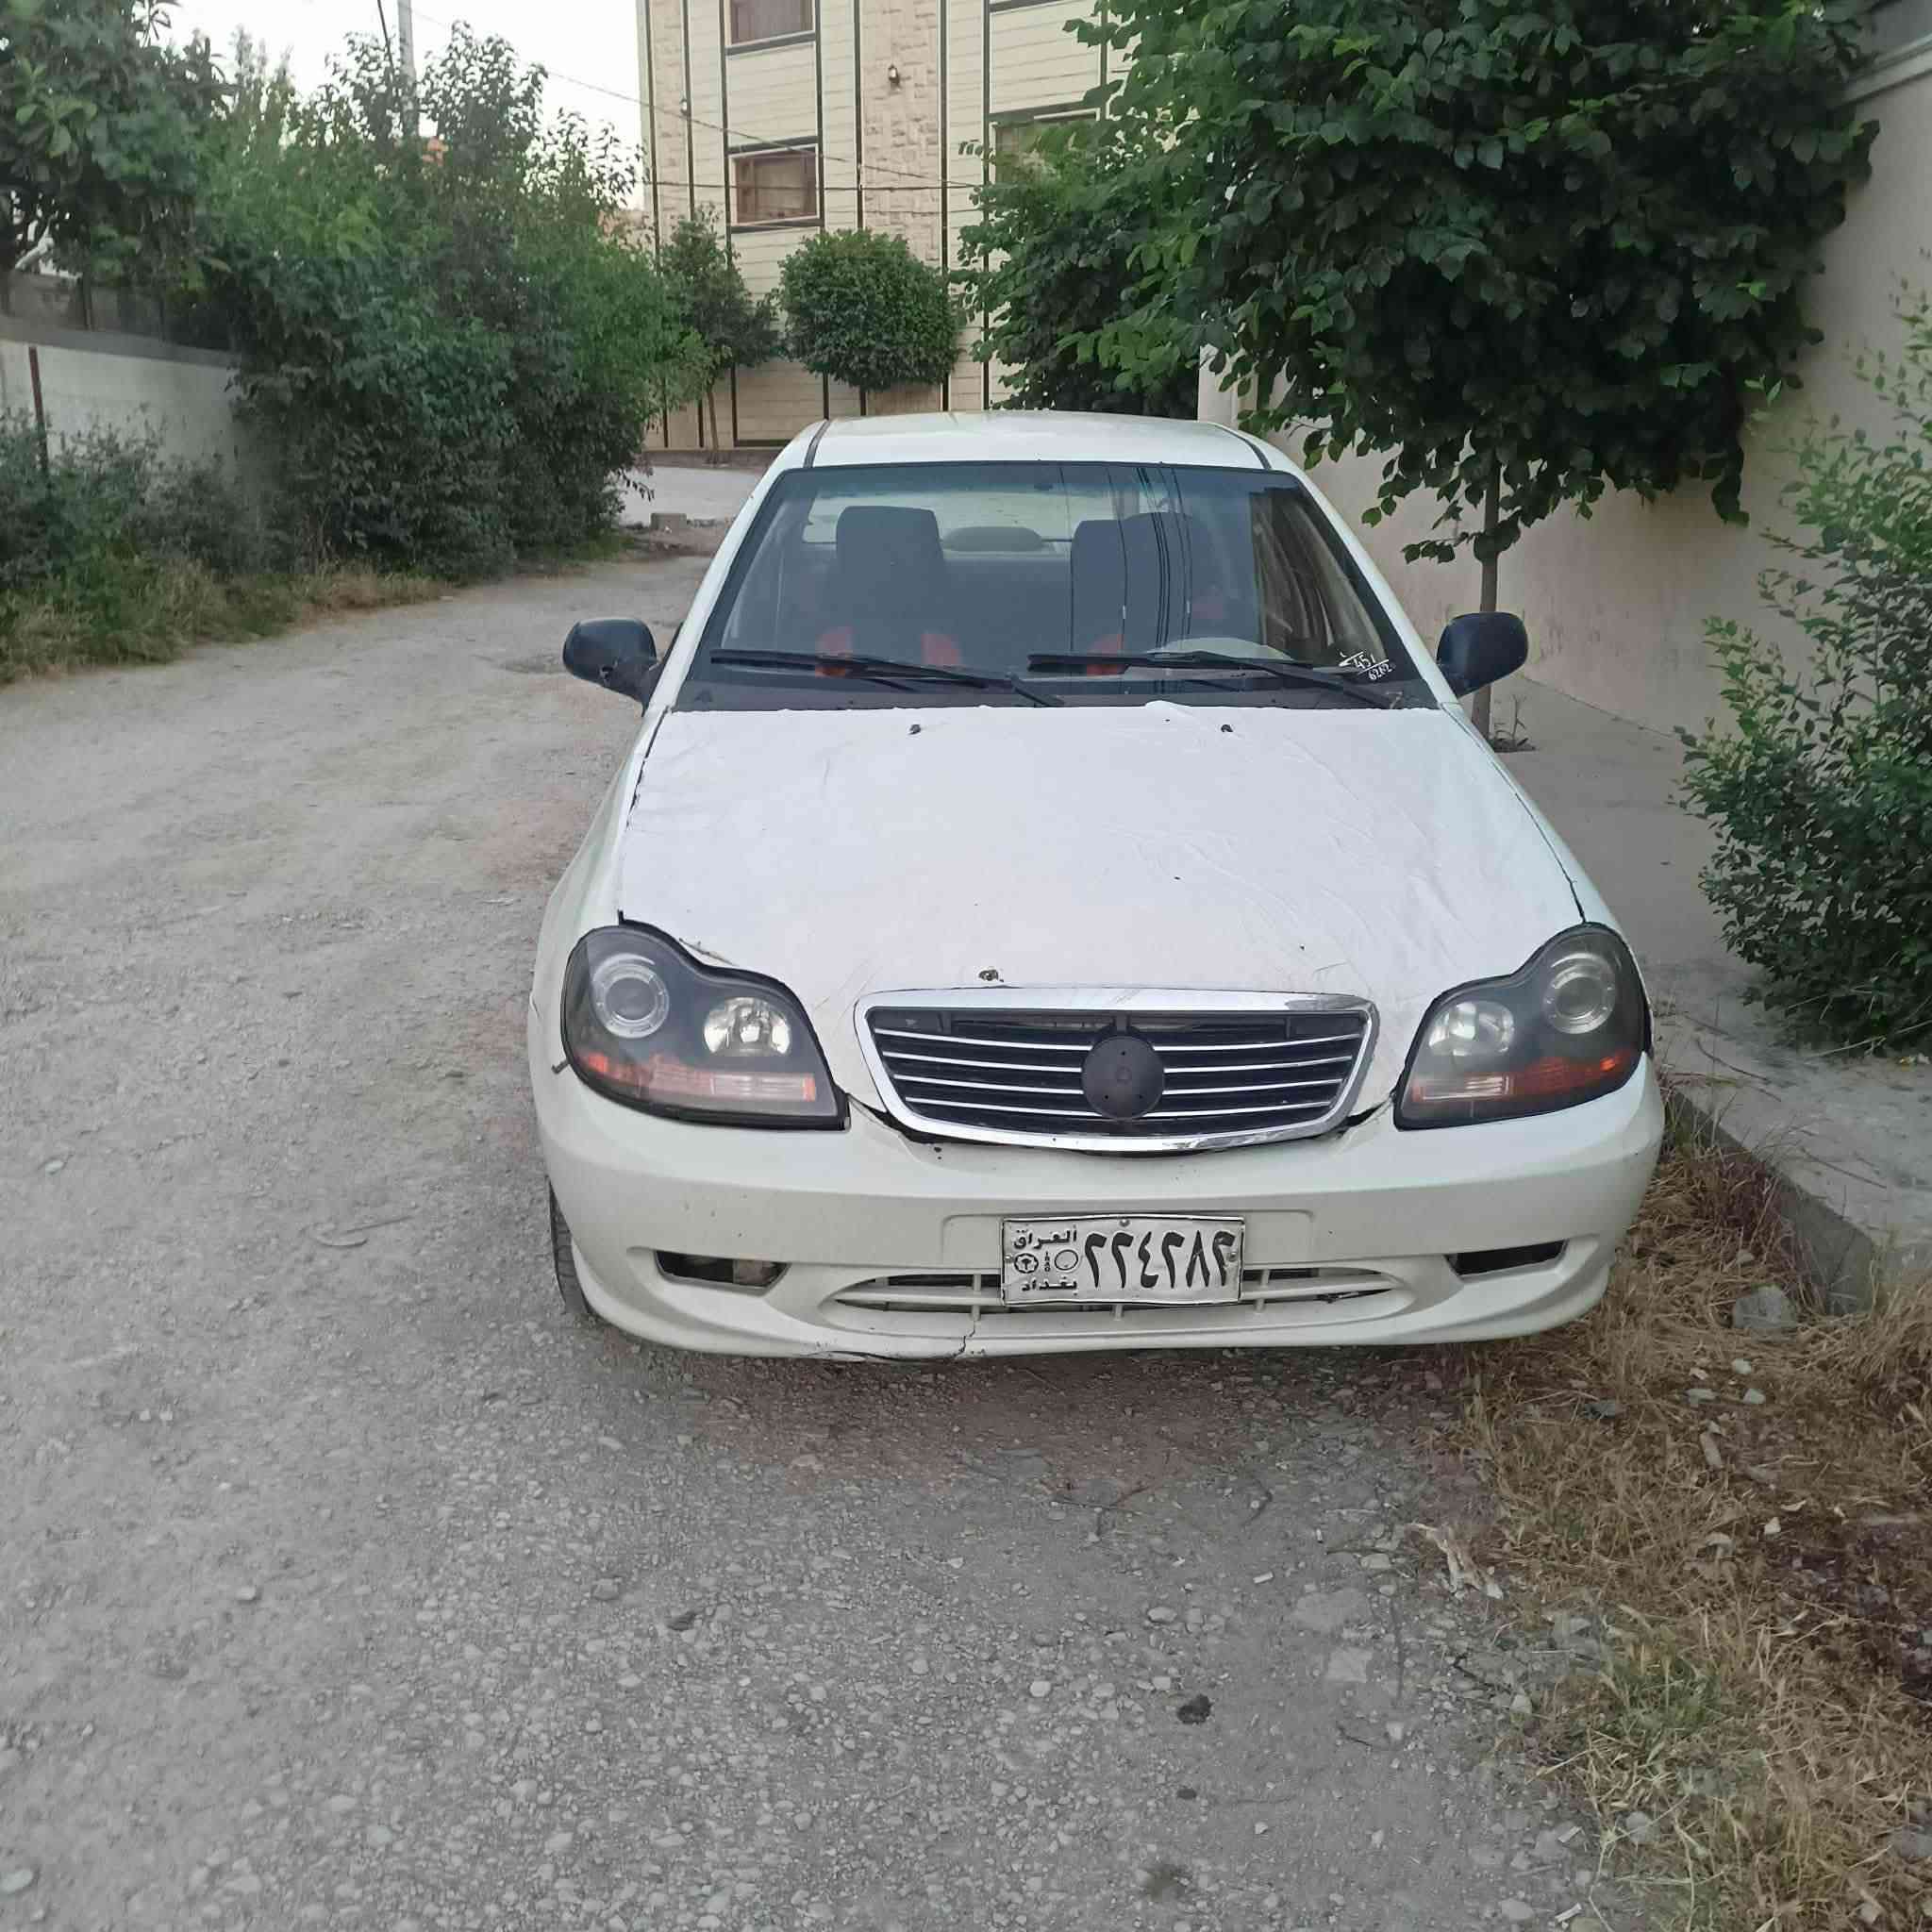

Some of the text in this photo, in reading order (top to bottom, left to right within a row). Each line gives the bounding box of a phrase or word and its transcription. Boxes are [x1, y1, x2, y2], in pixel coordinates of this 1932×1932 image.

[1014, 1229, 1077, 1250] العراق
[1084, 1229, 1236, 1290] ٢٢٤٢٨٢
[1021, 1276, 1077, 1296] بغداد
